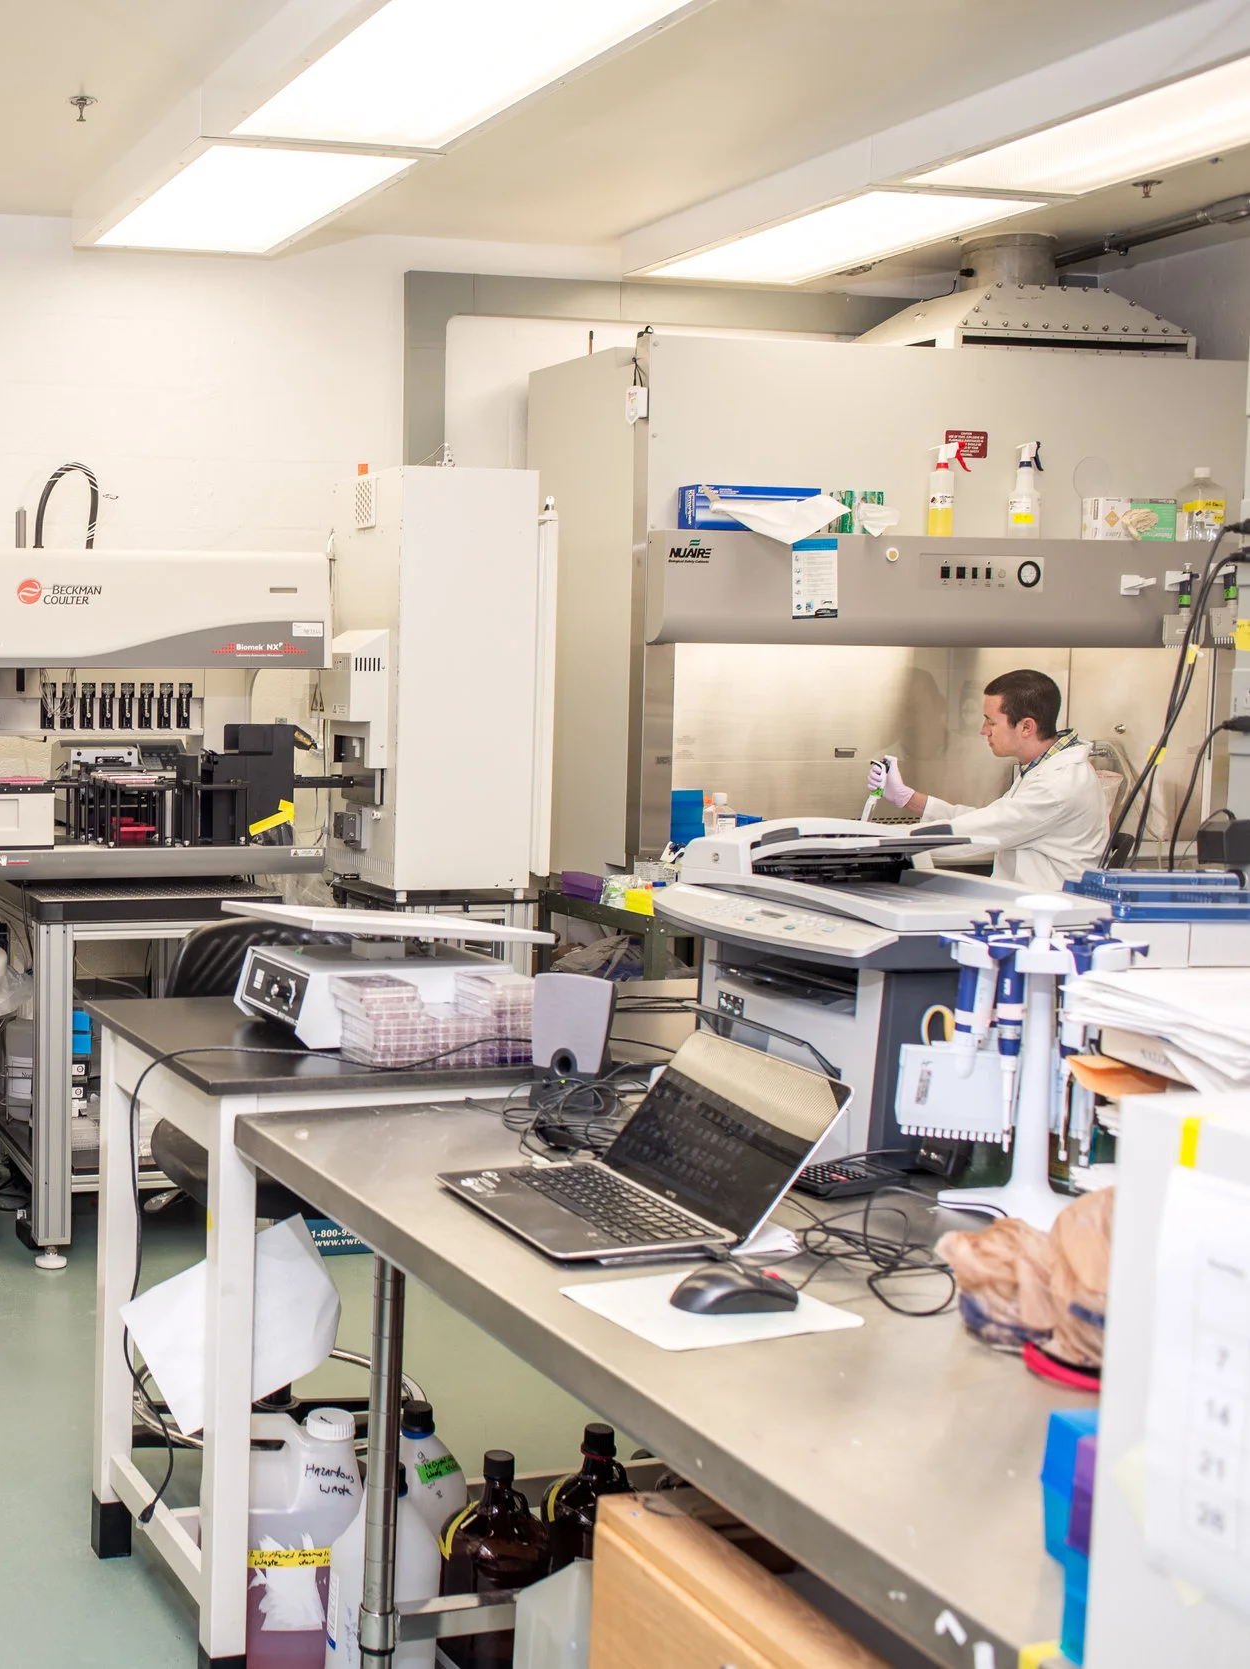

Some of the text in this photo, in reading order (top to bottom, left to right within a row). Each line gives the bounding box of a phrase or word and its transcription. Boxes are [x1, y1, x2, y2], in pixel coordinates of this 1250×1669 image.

[669, 547, 712, 558] NUAIRE
[52, 584, 102, 595] BECKMAN
[43, 595, 89, 605] COULTER
[314, 1238, 363, 1247] www.vwr.
[1205, 1397, 1231, 1428] 14
[1199, 1449, 1226, 1483] 21
